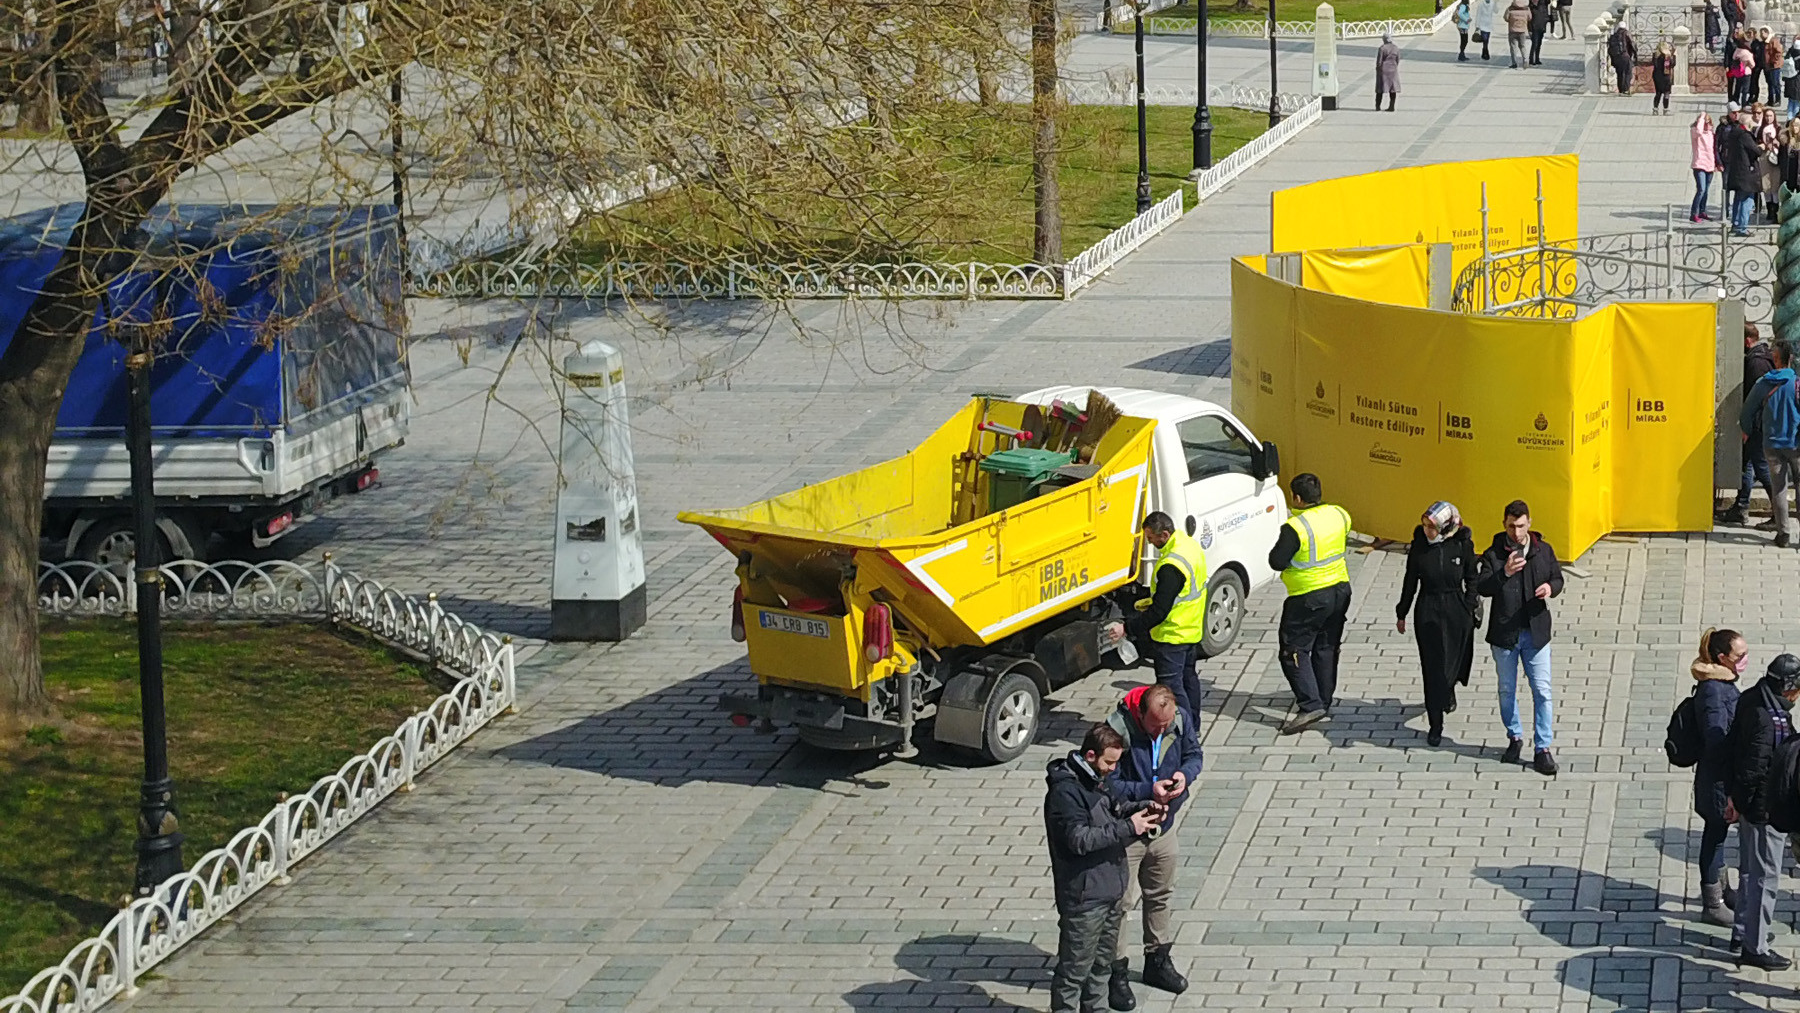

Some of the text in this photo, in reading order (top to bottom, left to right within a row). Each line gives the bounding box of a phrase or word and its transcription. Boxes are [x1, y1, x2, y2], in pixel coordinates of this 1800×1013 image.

[1356, 395, 1418, 416] Yılanlı Sütun
[1636, 398, 1665, 412] İBB
[1350, 412, 1383, 430] Restore
[1387, 419, 1425, 437] Ediliyor
[1446, 411, 1471, 429] İBB
[1635, 414, 1667, 423] MİRAS
[1446, 429, 1473, 440] MİRAS
[766, 615, 778, 628] 34
[807, 621, 825, 636] 815
